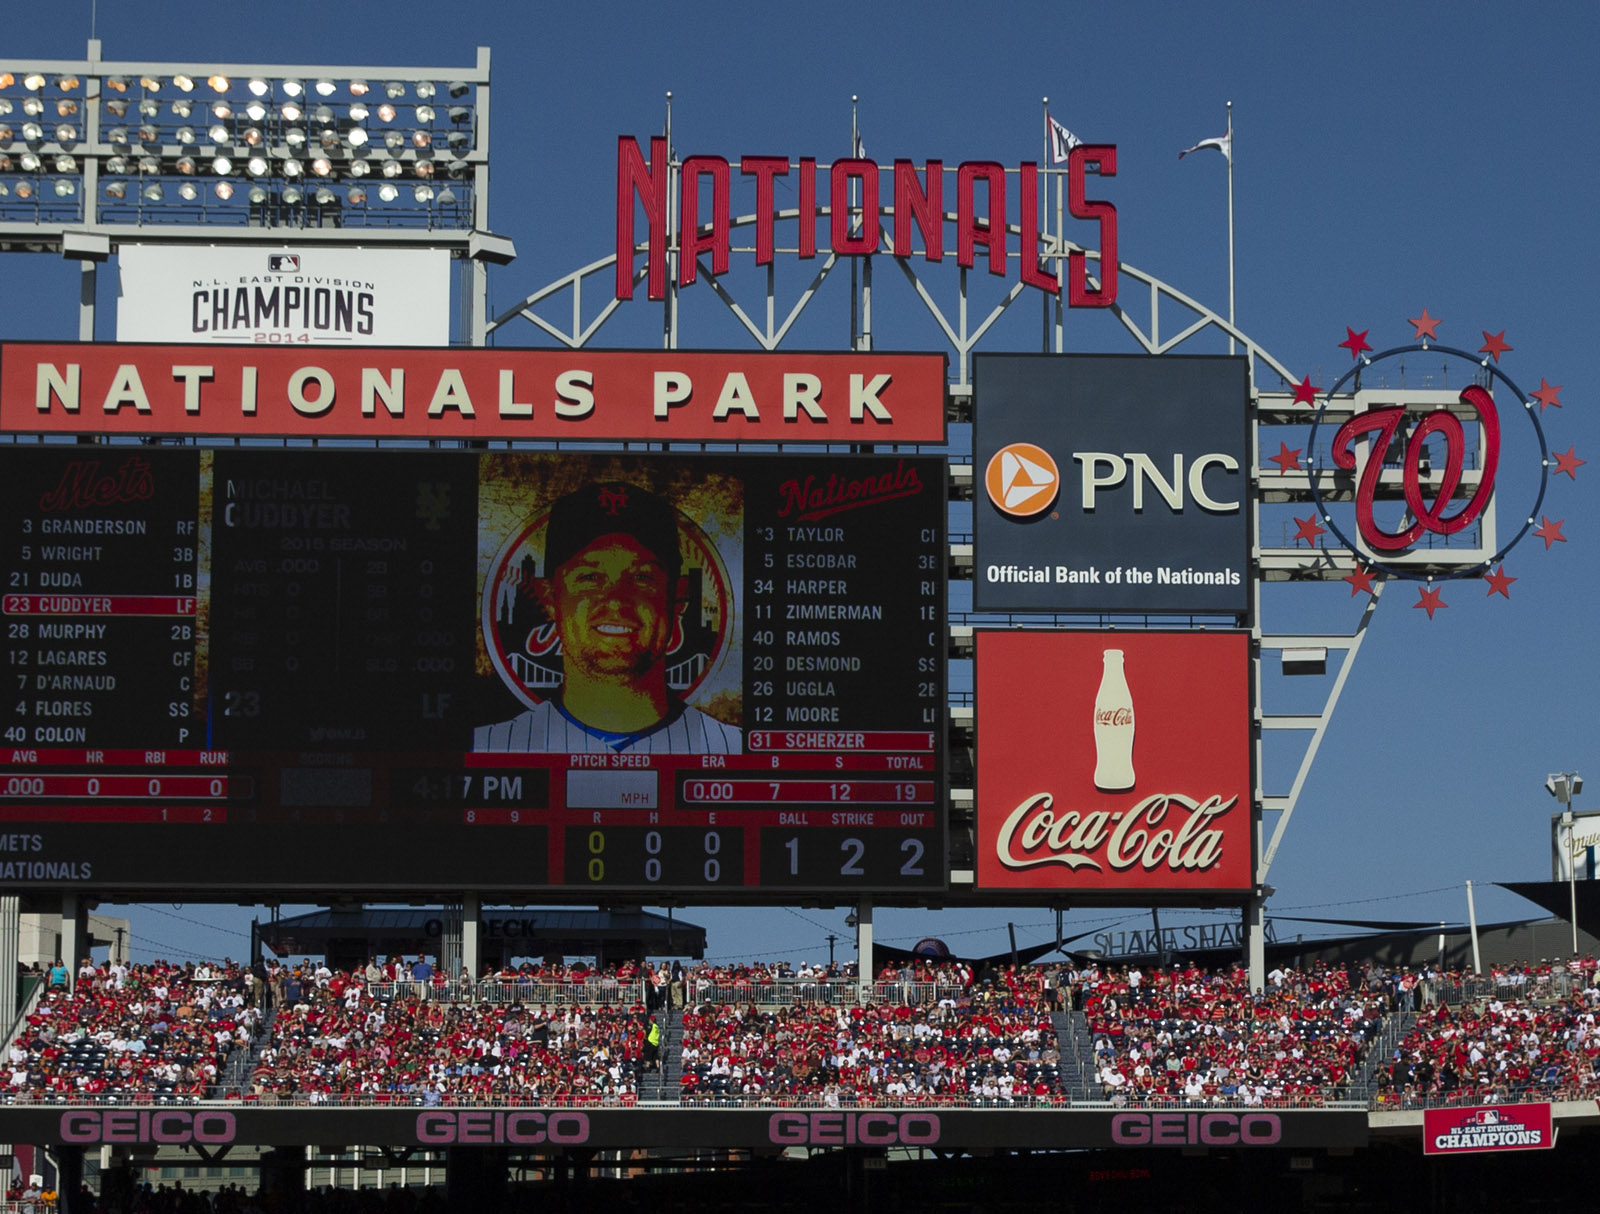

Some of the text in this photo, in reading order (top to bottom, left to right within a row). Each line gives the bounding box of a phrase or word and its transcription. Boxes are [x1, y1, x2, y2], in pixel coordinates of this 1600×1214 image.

[615, 135, 1118, 308] NATIONALS
[239, 275, 284, 285] EAST
[294, 275, 376, 290] DIVISION
[192, 286, 375, 336] CHAMPIONS
[254, 333, 310, 344] 2014
[35, 363, 892, 421] NATIONALS PARK
[40, 457, 155, 512] Mets
[1072, 452, 1241, 512] PNC
[777, 459, 923, 522] Nationals
[22, 518, 195, 535] 3 GRANDERSON RF
[787, 528, 845, 542] TAYLOR
[22, 546, 193, 562] 5 WRIGHT 3B
[764, 554, 774, 568] 5
[787, 554, 857, 568] ESCOBAR
[10, 572, 193, 588] 21 DUDA 1B
[986, 565, 1241, 585] Official Bank of the Nationals
[754, 580, 774, 594] 34
[787, 580, 847, 594] HARPER
[9, 598, 193, 614] 23 CUDDYER LF
[756, 605, 772, 619] 11
[786, 605, 882, 619] ZIMMERMAN
[8, 624, 192, 640] 28 MURPHY 2B
[753, 631, 774, 645] 40
[786, 631, 840, 646] RAMOS
[10, 650, 192, 666] 12 LAGARES CF
[753, 656, 774, 671] 20
[786, 657, 861, 671] DESMOND
[17, 674, 190, 691] 7 D'ARNAUD C
[753, 681, 773, 696] 26
[786, 681, 836, 696] UGGLA
[15, 700, 190, 717] 4 FLORES SS
[754, 707, 773, 722] 12
[786, 707, 840, 722] MOORE
[4, 727, 190, 743] 40 COLON P
[752, 733, 771, 748] 31
[785, 733, 865, 748] SCHERZER
[11, 750, 38, 763] AVG
[86, 751, 104, 763] HR
[145, 751, 166, 764] RBI
[570, 755, 651, 767] PITCH SPEED
[701, 756, 923, 769] ERA B S TOTAL
[3, 778, 223, 796] .000 0 0 0
[483, 776, 523, 800] PM
[693, 783, 916, 801] 0.00 7 12 19
[621, 793, 649, 804] MPH
[161, 809, 520, 823] 1 2 8 9
[593, 811, 716, 824] R H E
[778, 813, 925, 825] BALL STRIKE OUT
[996, 792, 1238, 869] Coca-Cola
[588, 830, 721, 855] 0 0 0
[785, 837, 925, 876] 1 2 2
[588, 858, 721, 882] 0 0 0
[60, 1110, 236, 1144] GEICO
[416, 1111, 590, 1145] GEICO
[768, 1112, 940, 1146] GEICO
[1111, 1113, 1281, 1146] GEICO
[1487, 1123, 1525, 1134] DIVISION
[1435, 1130, 1542, 1149] CHAMPIONS
